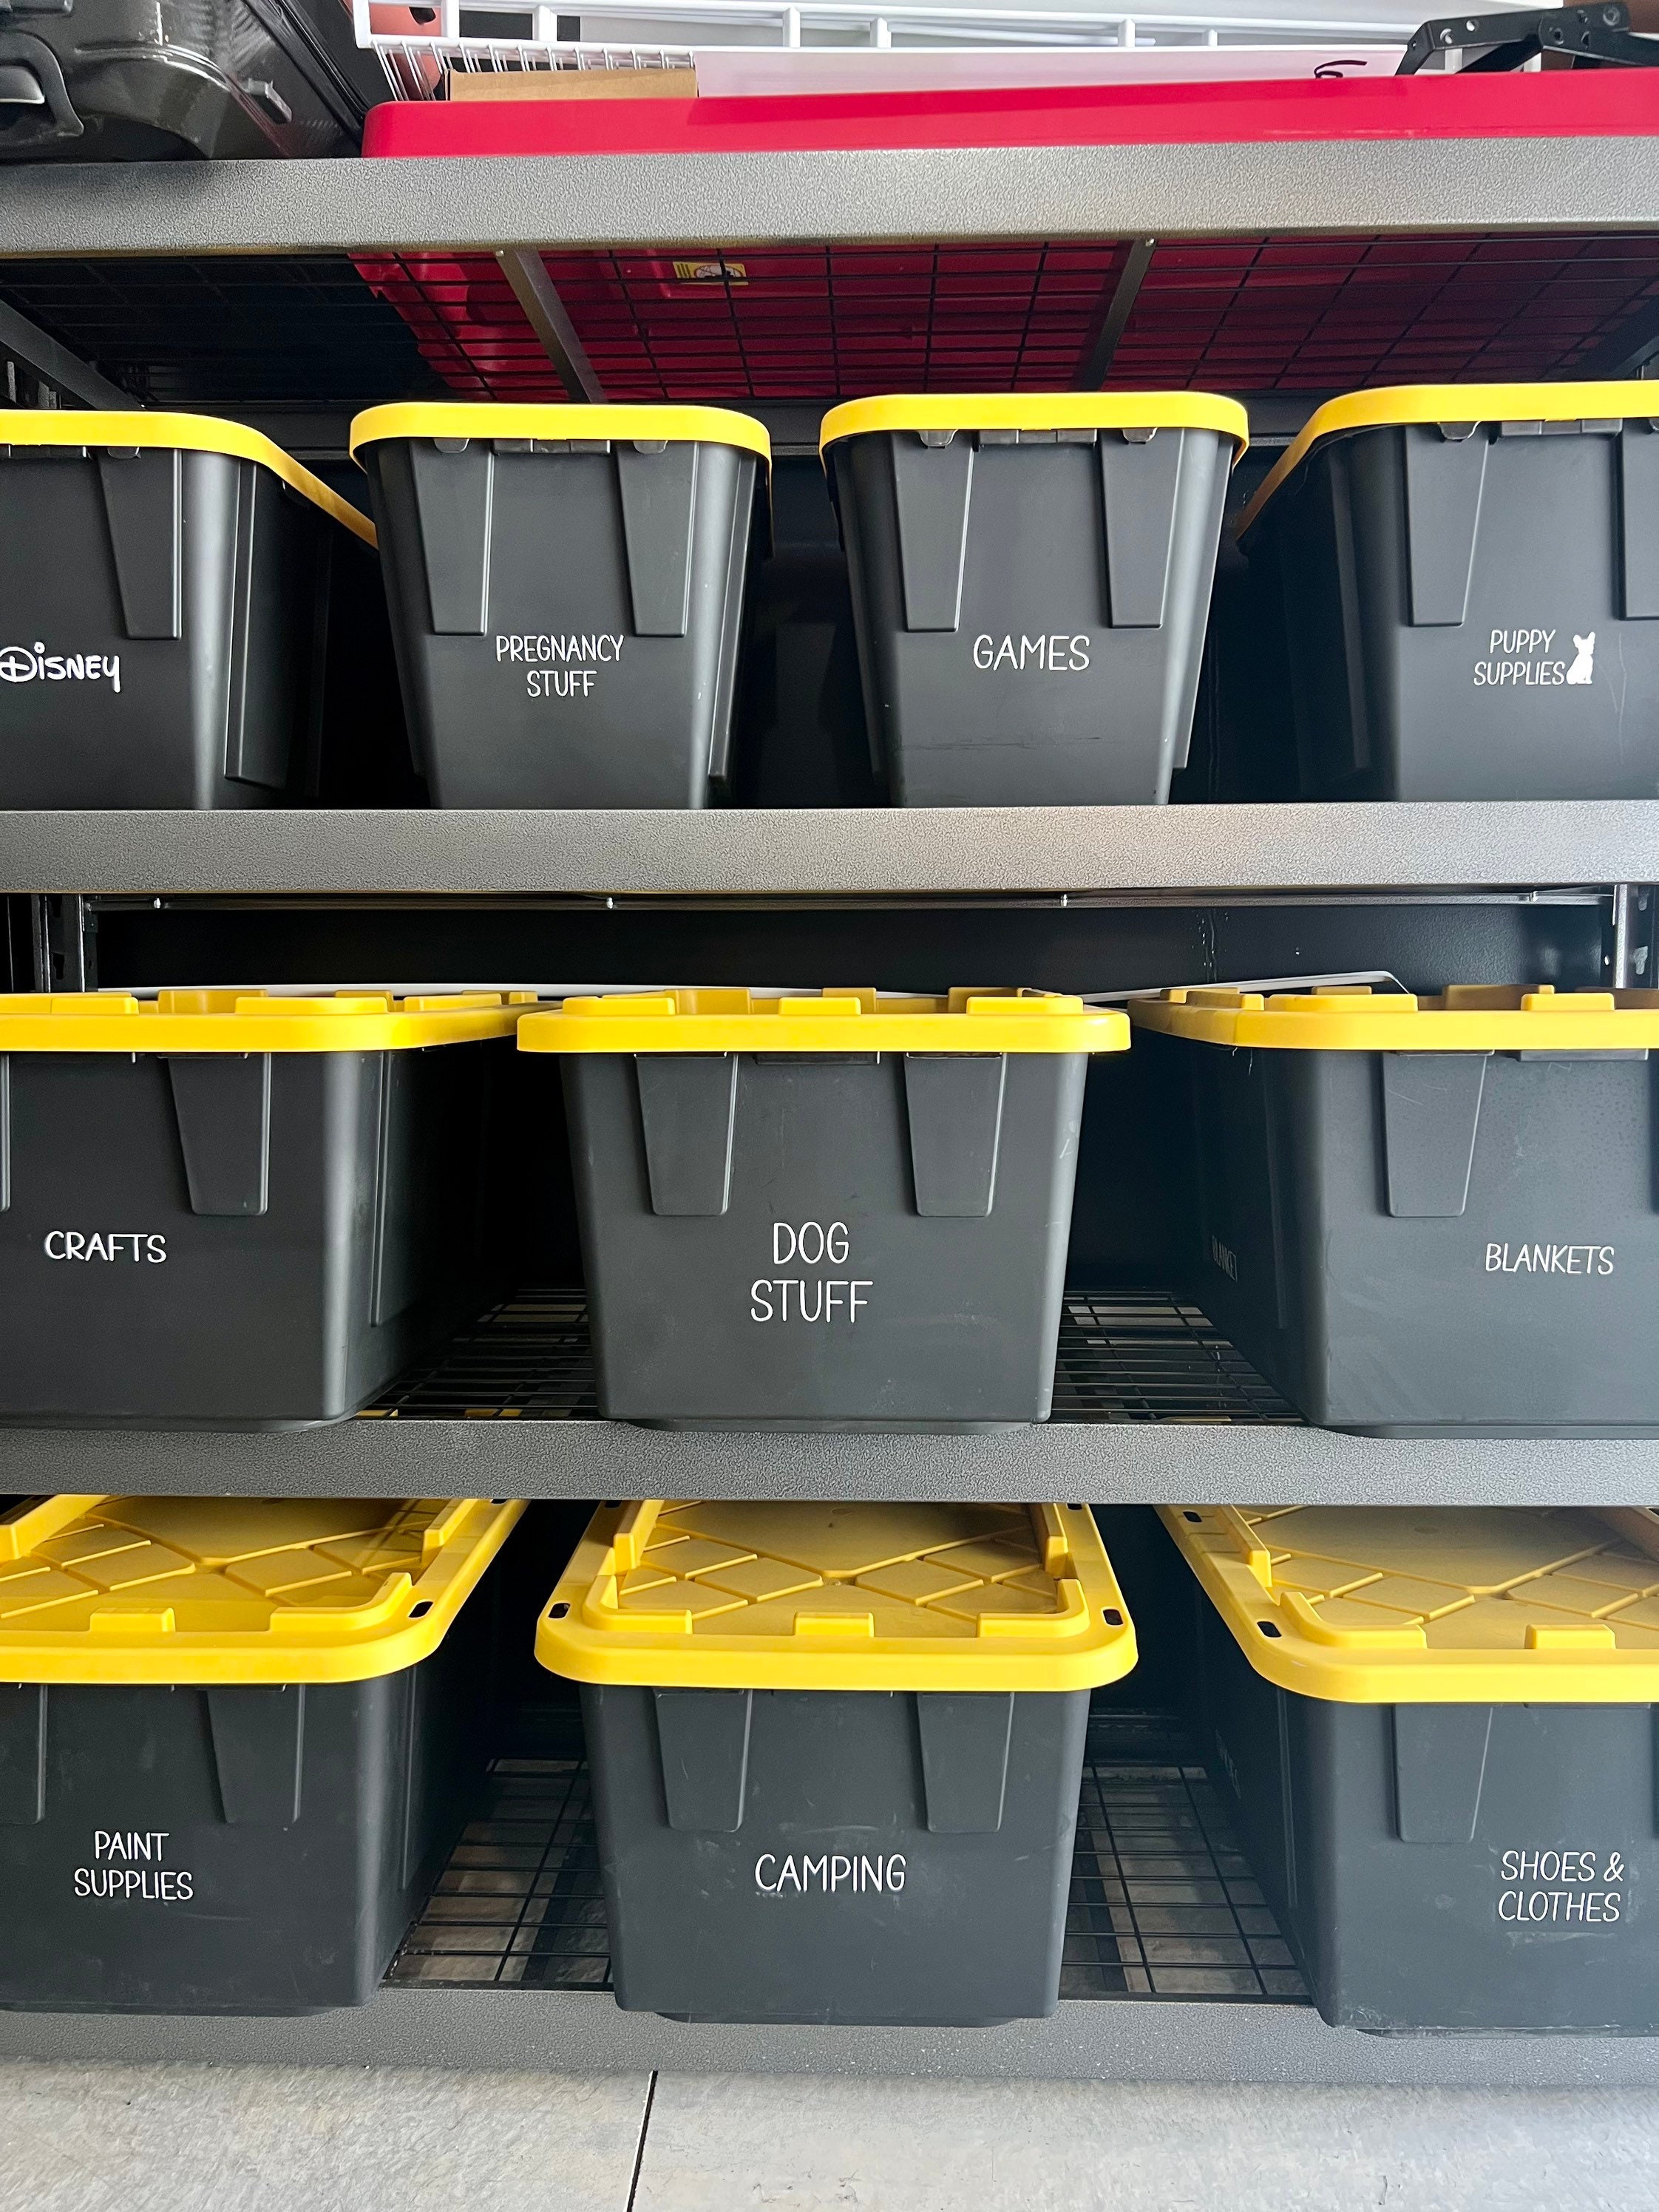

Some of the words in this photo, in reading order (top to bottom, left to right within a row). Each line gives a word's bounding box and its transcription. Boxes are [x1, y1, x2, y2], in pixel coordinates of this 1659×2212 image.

[495, 634, 625, 662] PREGNANCY
[973, 634, 1090, 671] GAMES
[1490, 628, 1556, 654] PUPPY
[526, 670, 597, 698] STUFF
[1473, 661, 1566, 686] SUPPLIES
[44, 1230, 167, 1263] CRAFTS
[773, 1221, 849, 1265] DOG
[1485, 1243, 1615, 1275] BLANKETS
[750, 1279, 874, 1323] STUFF
[95, 1831, 170, 1862] PAINT
[755, 1853, 906, 1894] CAMPING
[1501, 1850, 1596, 1882] SHOES
[1603, 1851, 1625, 1882] &
[74, 1867, 194, 1901] SUPPLIES
[1498, 1890, 1621, 1922] CLOTHES
